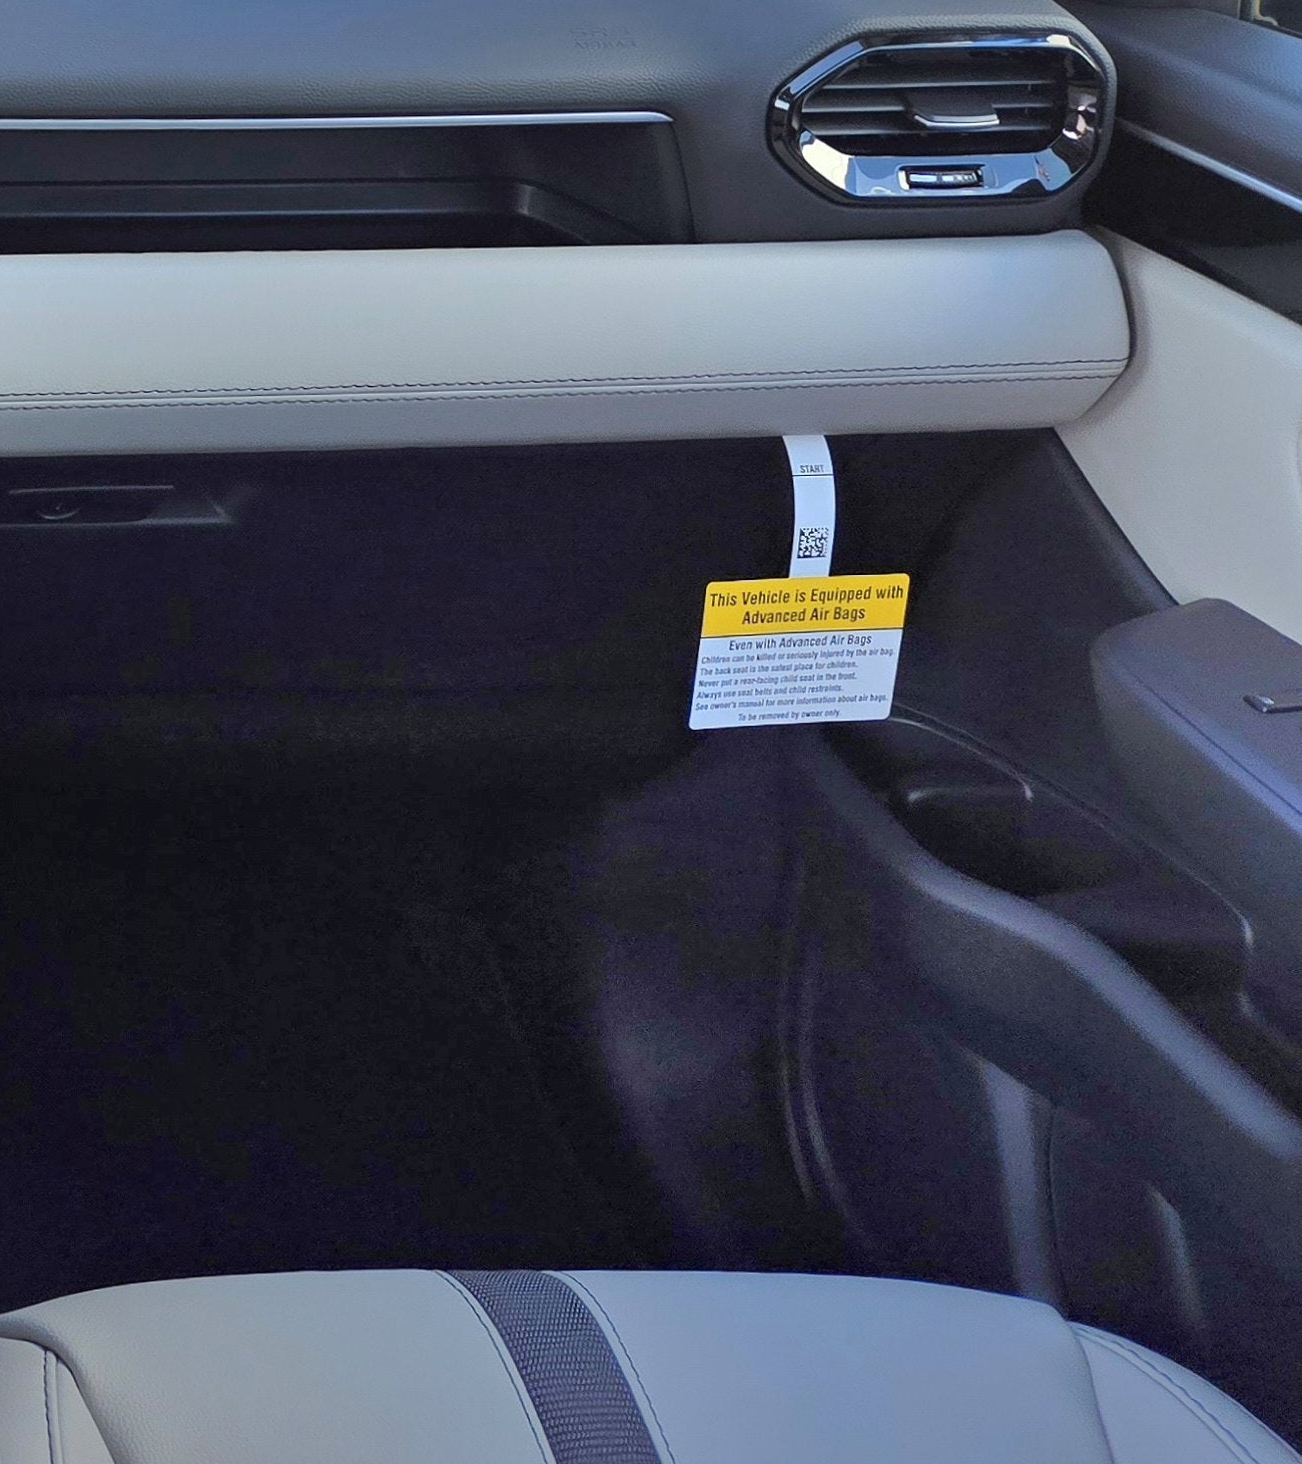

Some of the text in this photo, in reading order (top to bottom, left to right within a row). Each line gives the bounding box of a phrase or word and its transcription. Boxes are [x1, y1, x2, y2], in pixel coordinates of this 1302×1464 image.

[799, 464, 825, 474] START
[710, 585, 903, 607] This Vehicle is Equipped with
[742, 606, 866, 624] Advanced Air Bags
[729, 634, 872, 651] Even with Advanced Air Bags
[701, 656, 730, 664] Children
[732, 655, 745, 663] can
[746, 654, 755, 662] be
[756, 653, 776, 661] killed
[787, 650, 818, 660] seriously
[820, 649, 844, 659] injured
[846, 649, 854, 658] by
[856, 648, 867, 656] the
[869, 648, 879, 656] air
